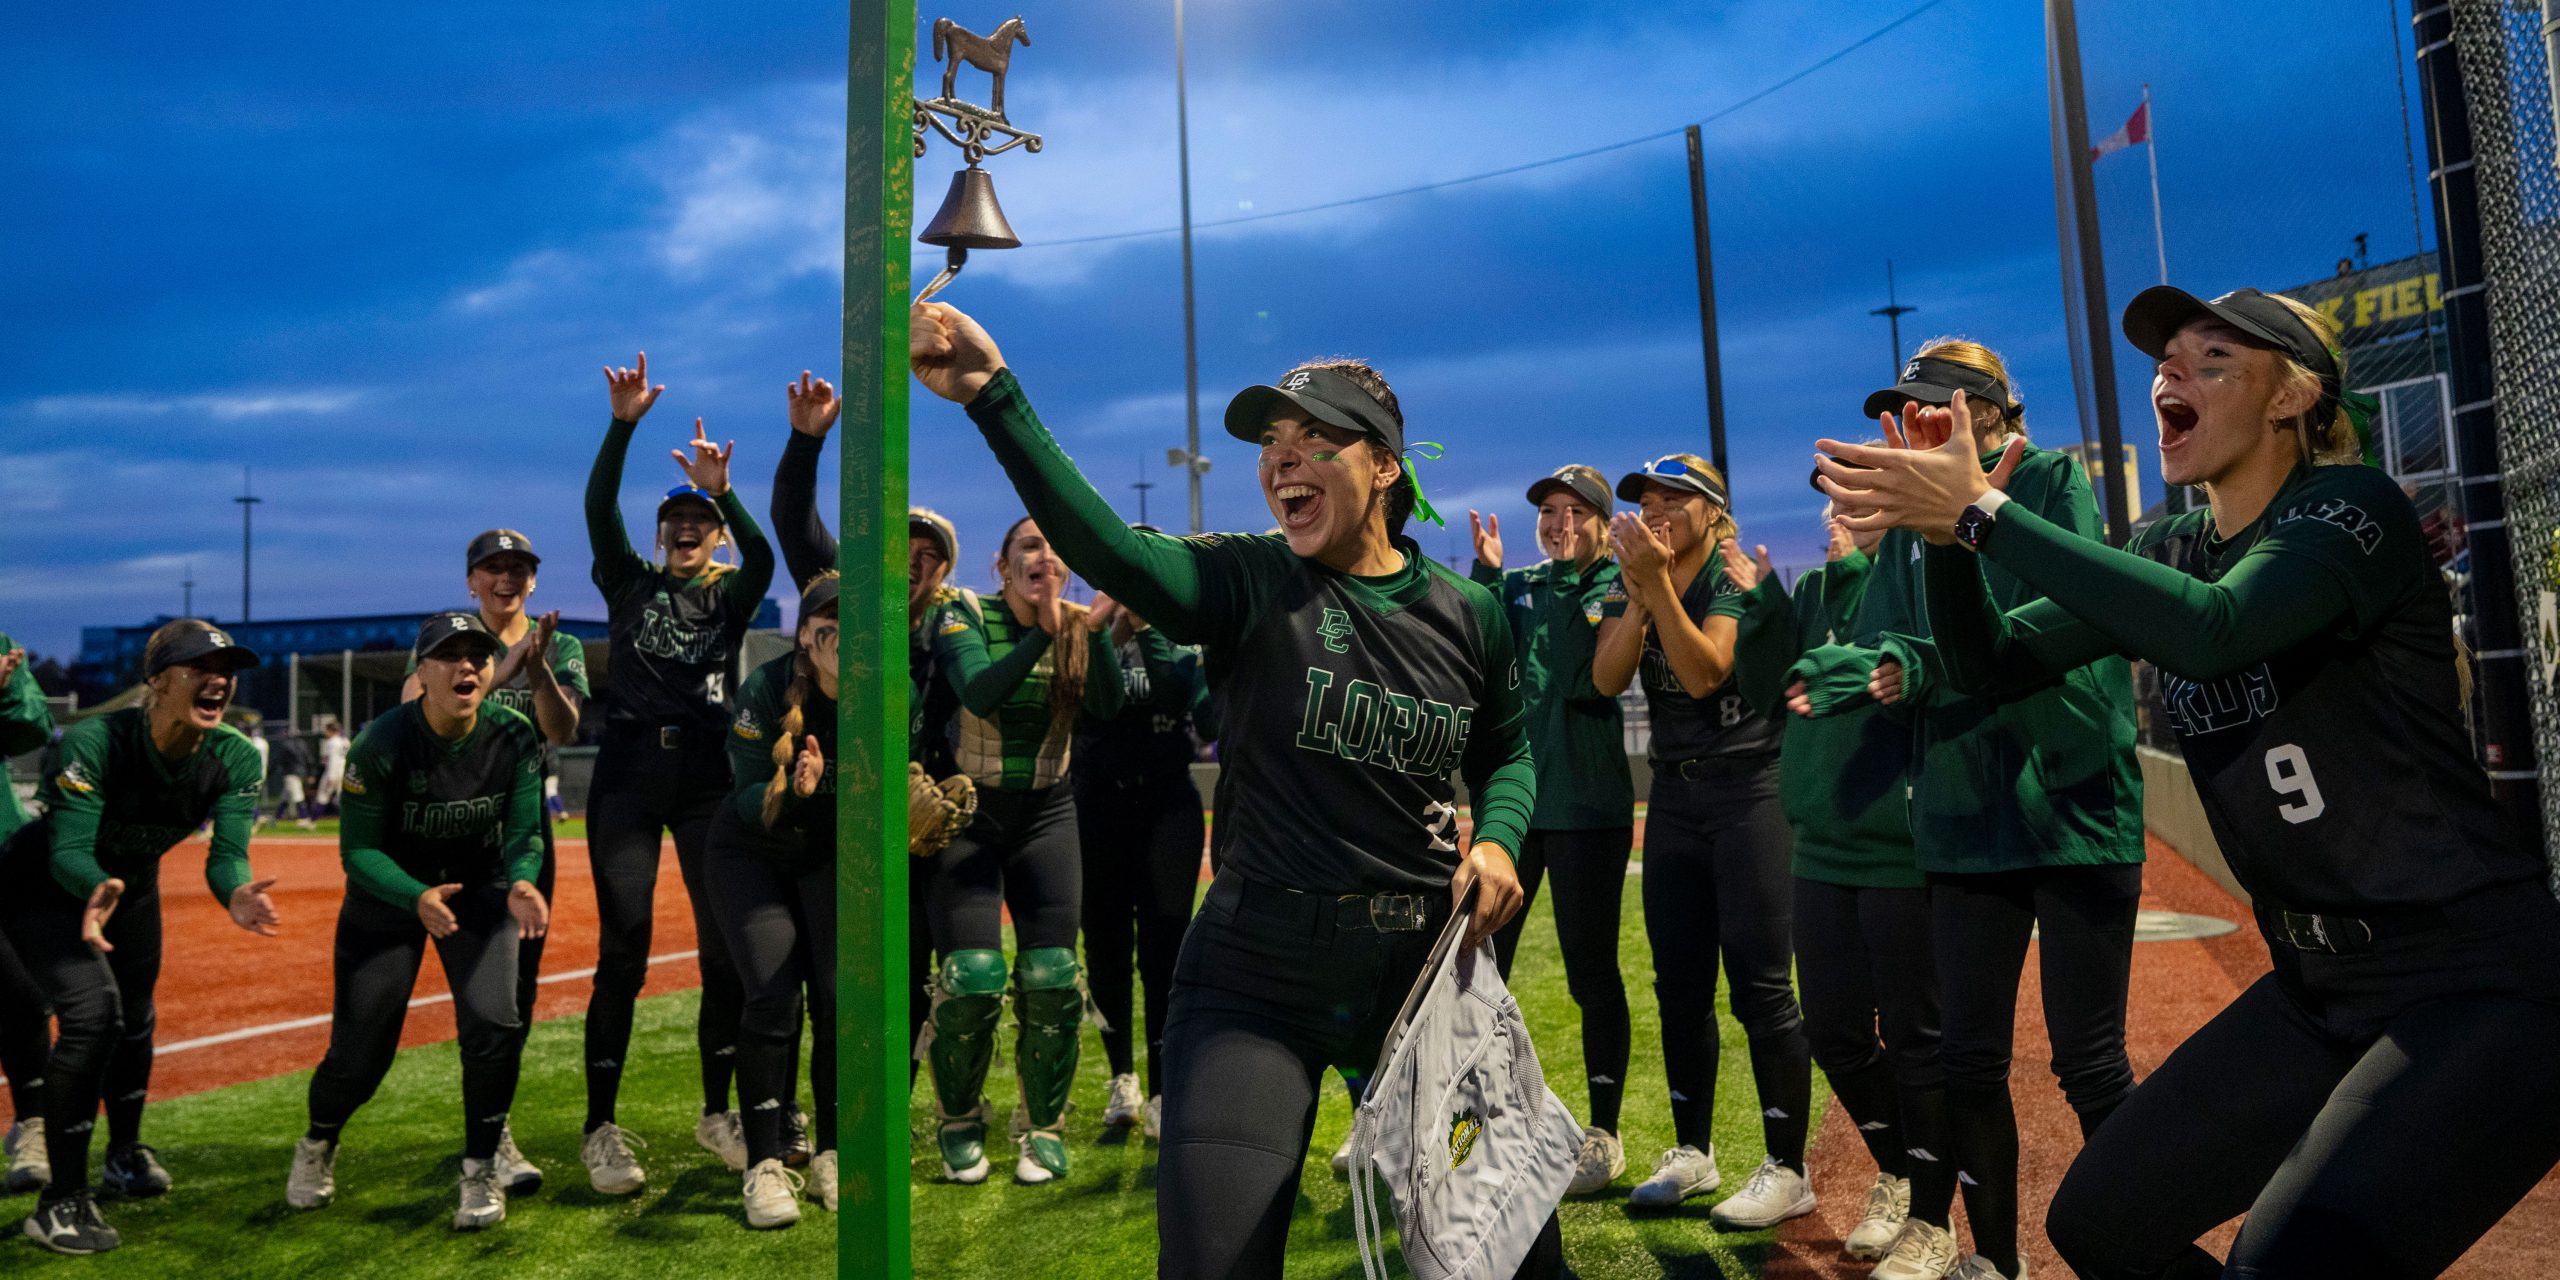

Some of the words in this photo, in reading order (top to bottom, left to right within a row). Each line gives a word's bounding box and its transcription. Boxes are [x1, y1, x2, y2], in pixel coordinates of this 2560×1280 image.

[2354, 273, 2445, 328] FIEL
[1296, 667, 1474, 780] LORDS
[2264, 743, 2326, 824] 9
